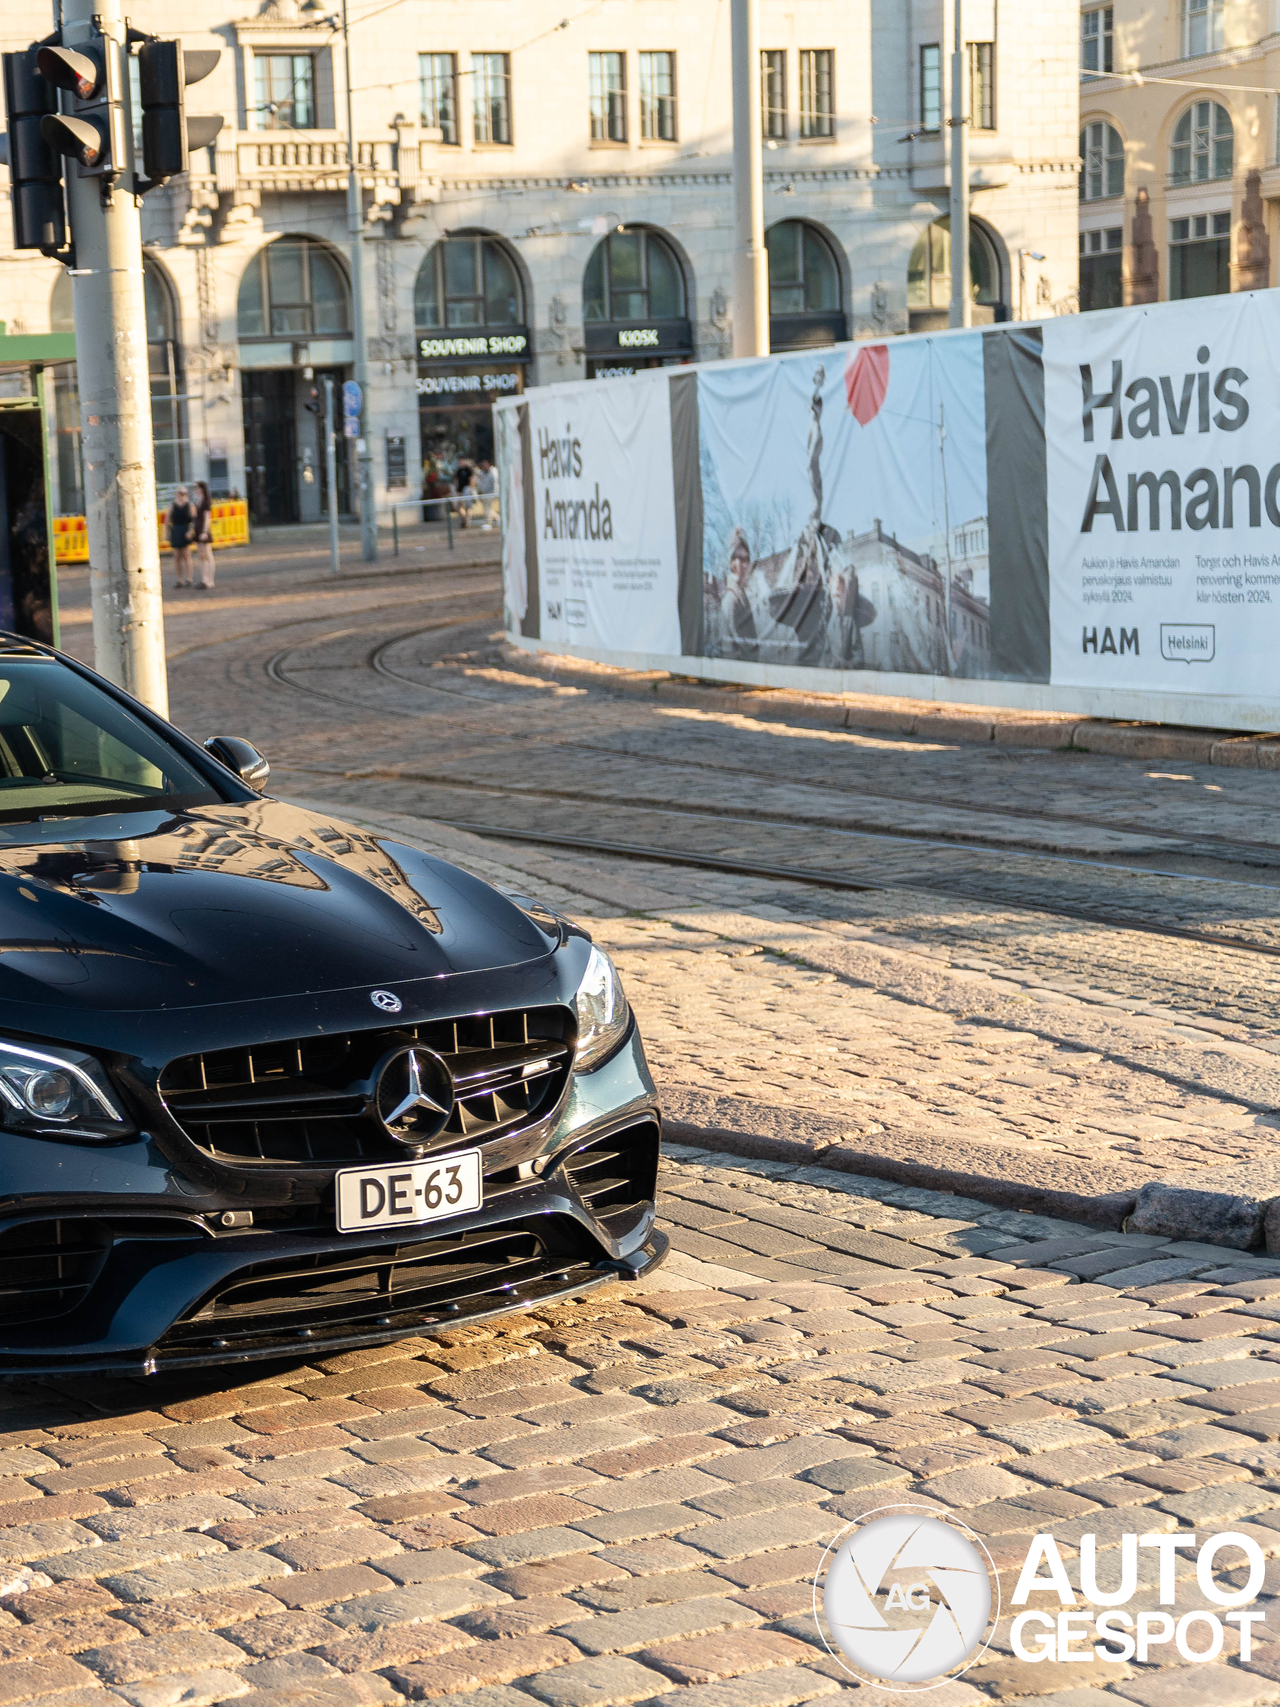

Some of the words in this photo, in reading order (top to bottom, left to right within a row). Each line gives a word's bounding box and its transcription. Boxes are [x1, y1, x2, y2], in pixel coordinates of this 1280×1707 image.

[420, 338, 488, 357] SOUVENIR
[489, 335, 526, 354] SHOP
[619, 329, 659, 346] KIOSK
[415, 377, 481, 395] SOUVENIR
[483, 374, 519, 391] SHOP
[1079, 345, 1250, 442] Havis
[538, 422, 583, 480] Havis
[544, 481, 613, 541] Amanda
[1222, 554, 1241, 568] och
[1243, 554, 1270, 568] Havis
[1082, 625, 1140, 656] HAM
[1168, 634, 1209, 650] Helsinki
[360, 1165, 463, 1220] DE-63
